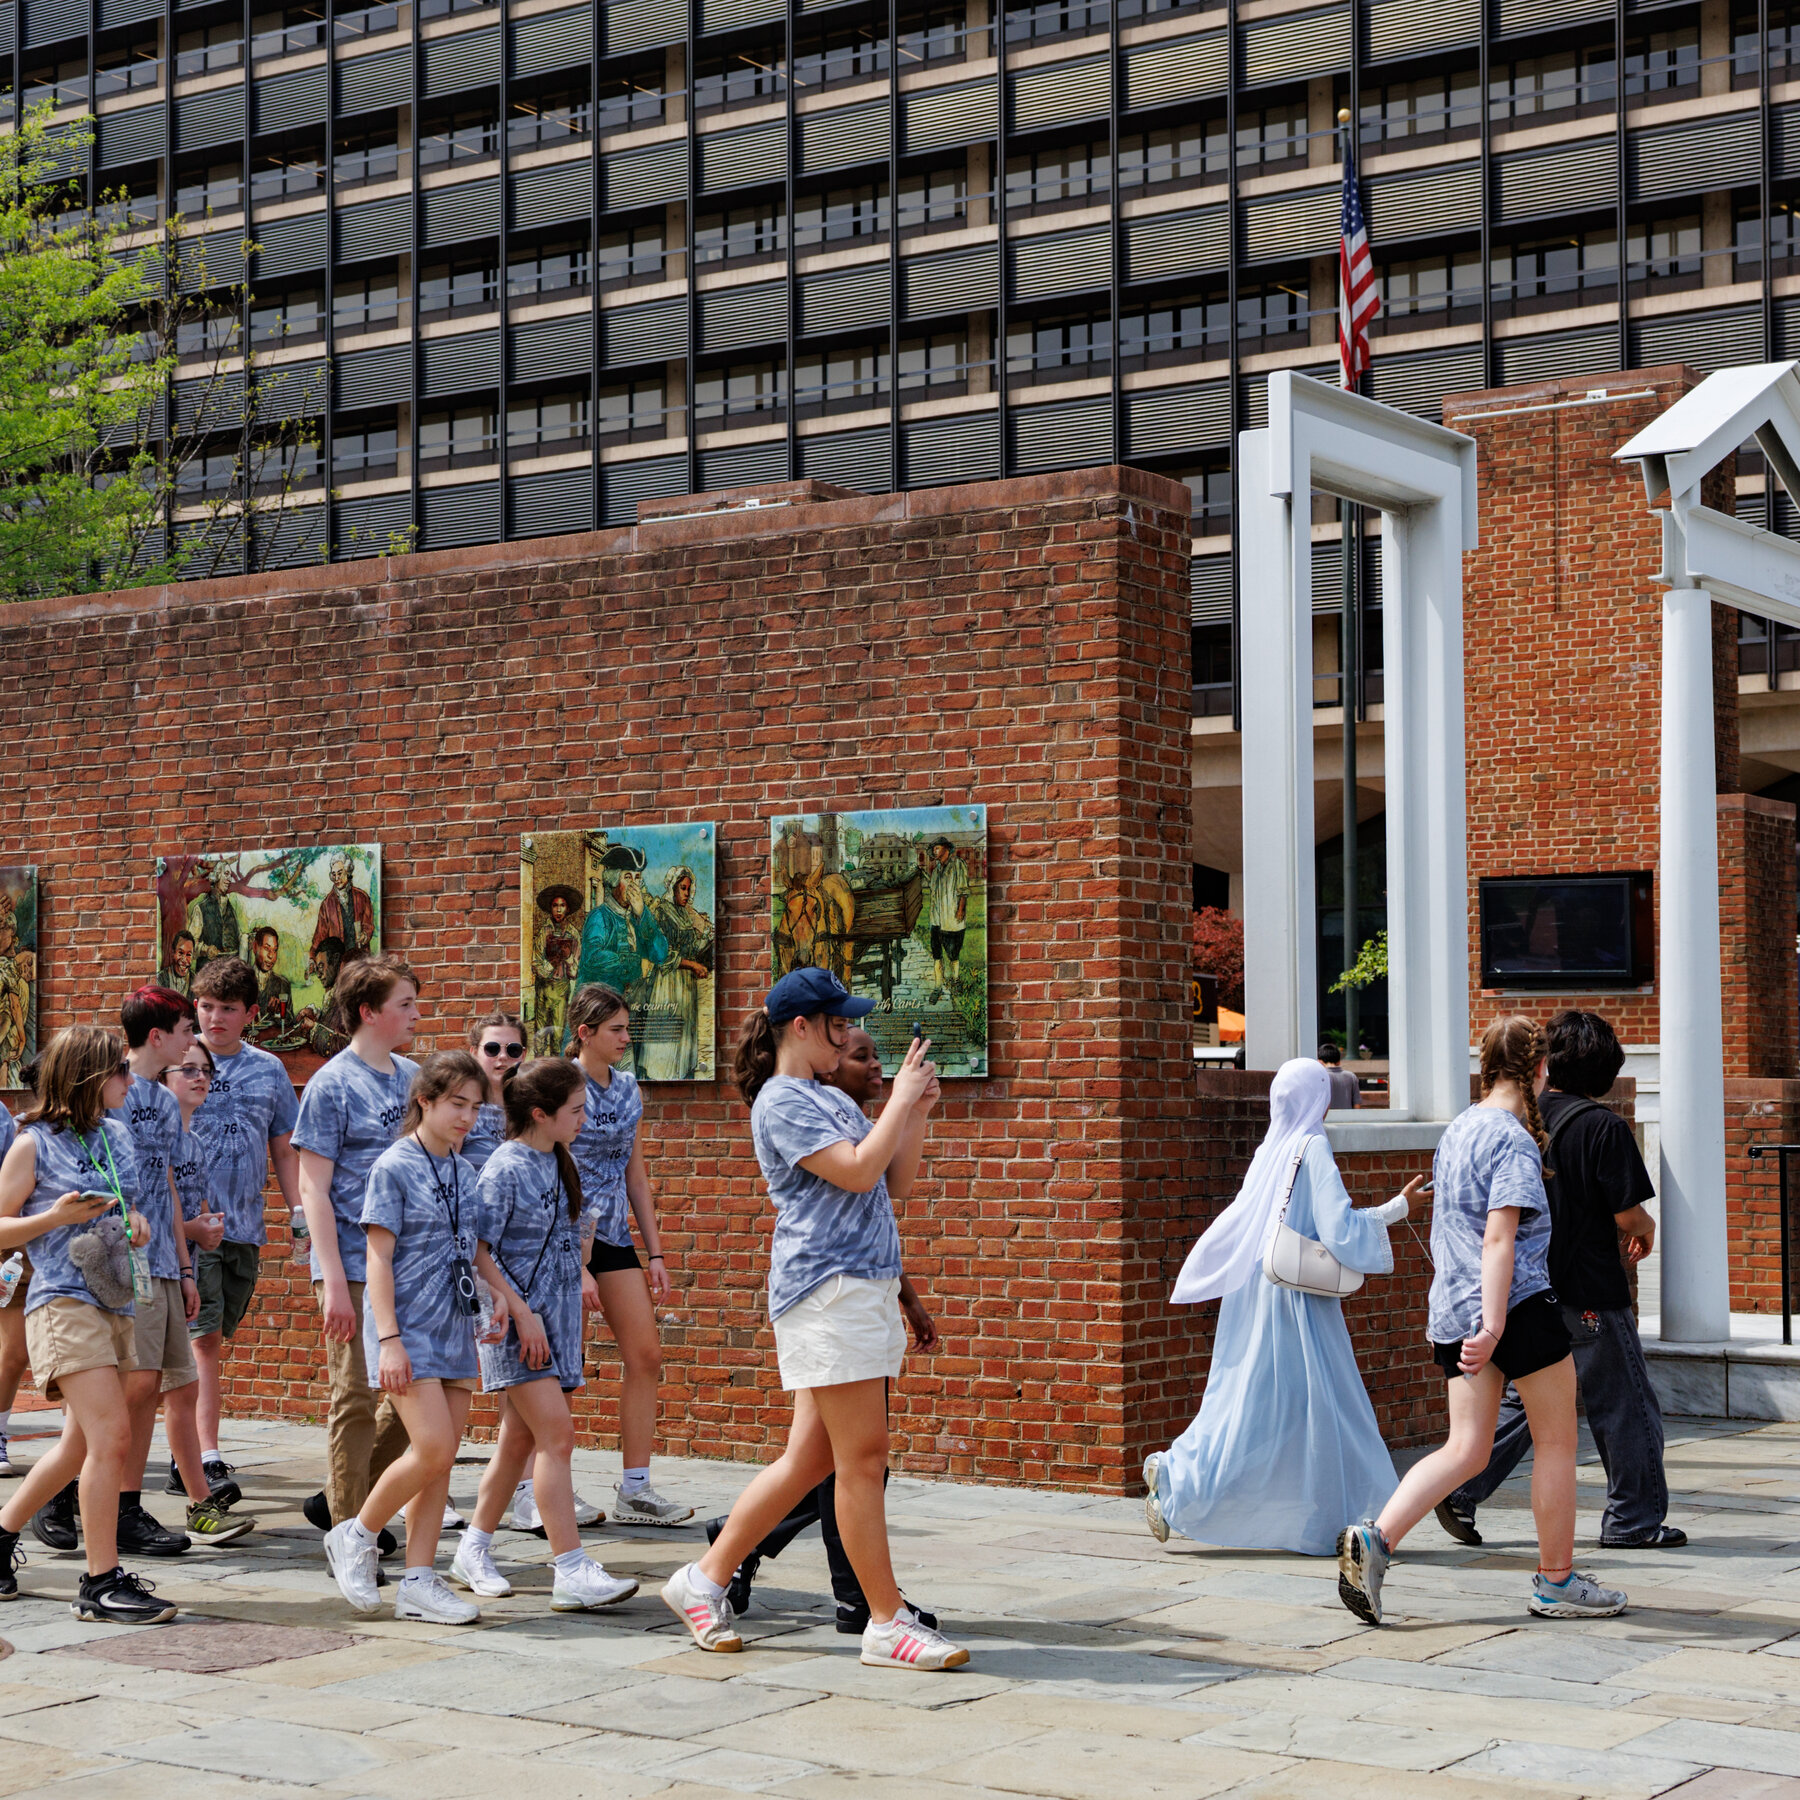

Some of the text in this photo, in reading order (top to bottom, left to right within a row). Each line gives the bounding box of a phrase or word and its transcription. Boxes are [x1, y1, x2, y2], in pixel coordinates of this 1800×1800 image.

[643, 1001, 678, 1016] country
[872, 997, 924, 1011] ath Carts
[208, 1080, 231, 1093] 026
[131, 1106, 158, 1125] 2026
[379, 1105, 407, 1128] 2026
[223, 1123, 238, 1135] 76
[610, 1148, 622, 1160] 76
[77, 1158, 108, 1174] 206
[150, 1156, 164, 1169] 76
